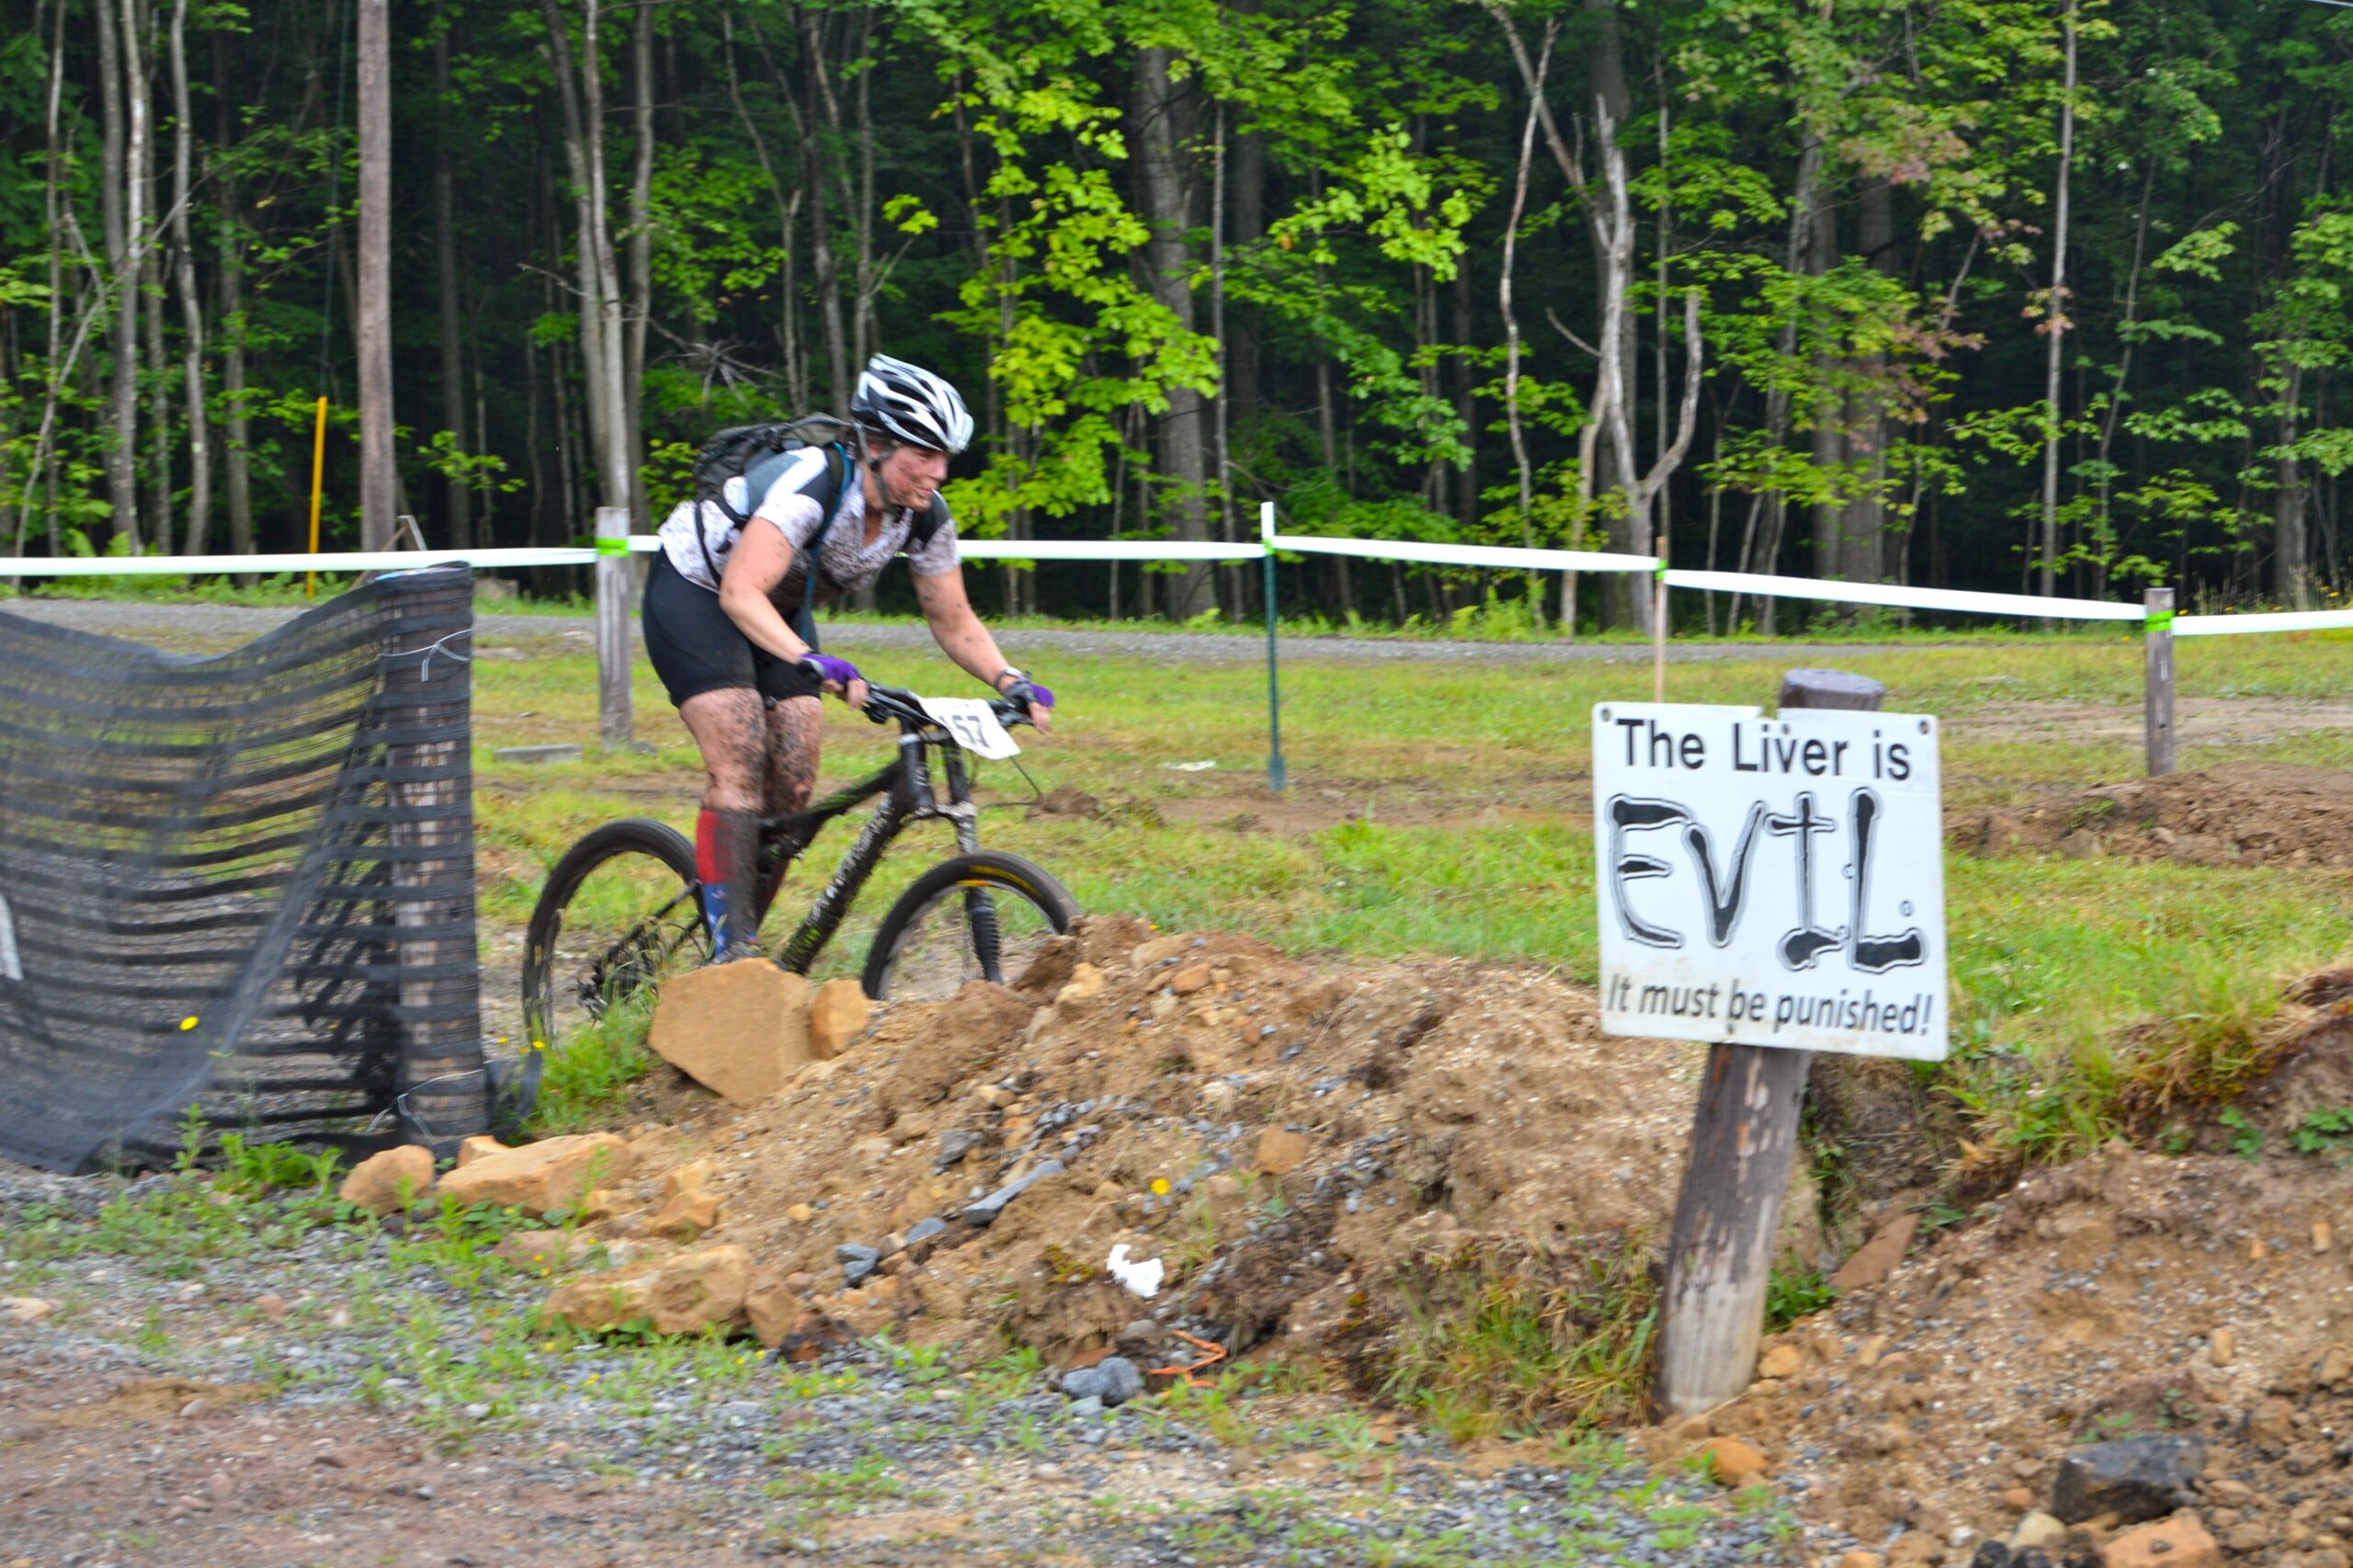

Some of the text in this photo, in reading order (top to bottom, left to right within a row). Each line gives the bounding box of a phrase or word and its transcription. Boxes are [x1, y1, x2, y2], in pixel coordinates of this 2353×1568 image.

[1615, 718, 1912, 781] The Liver is
[1606, 973, 1933, 1036] It must be punished!
